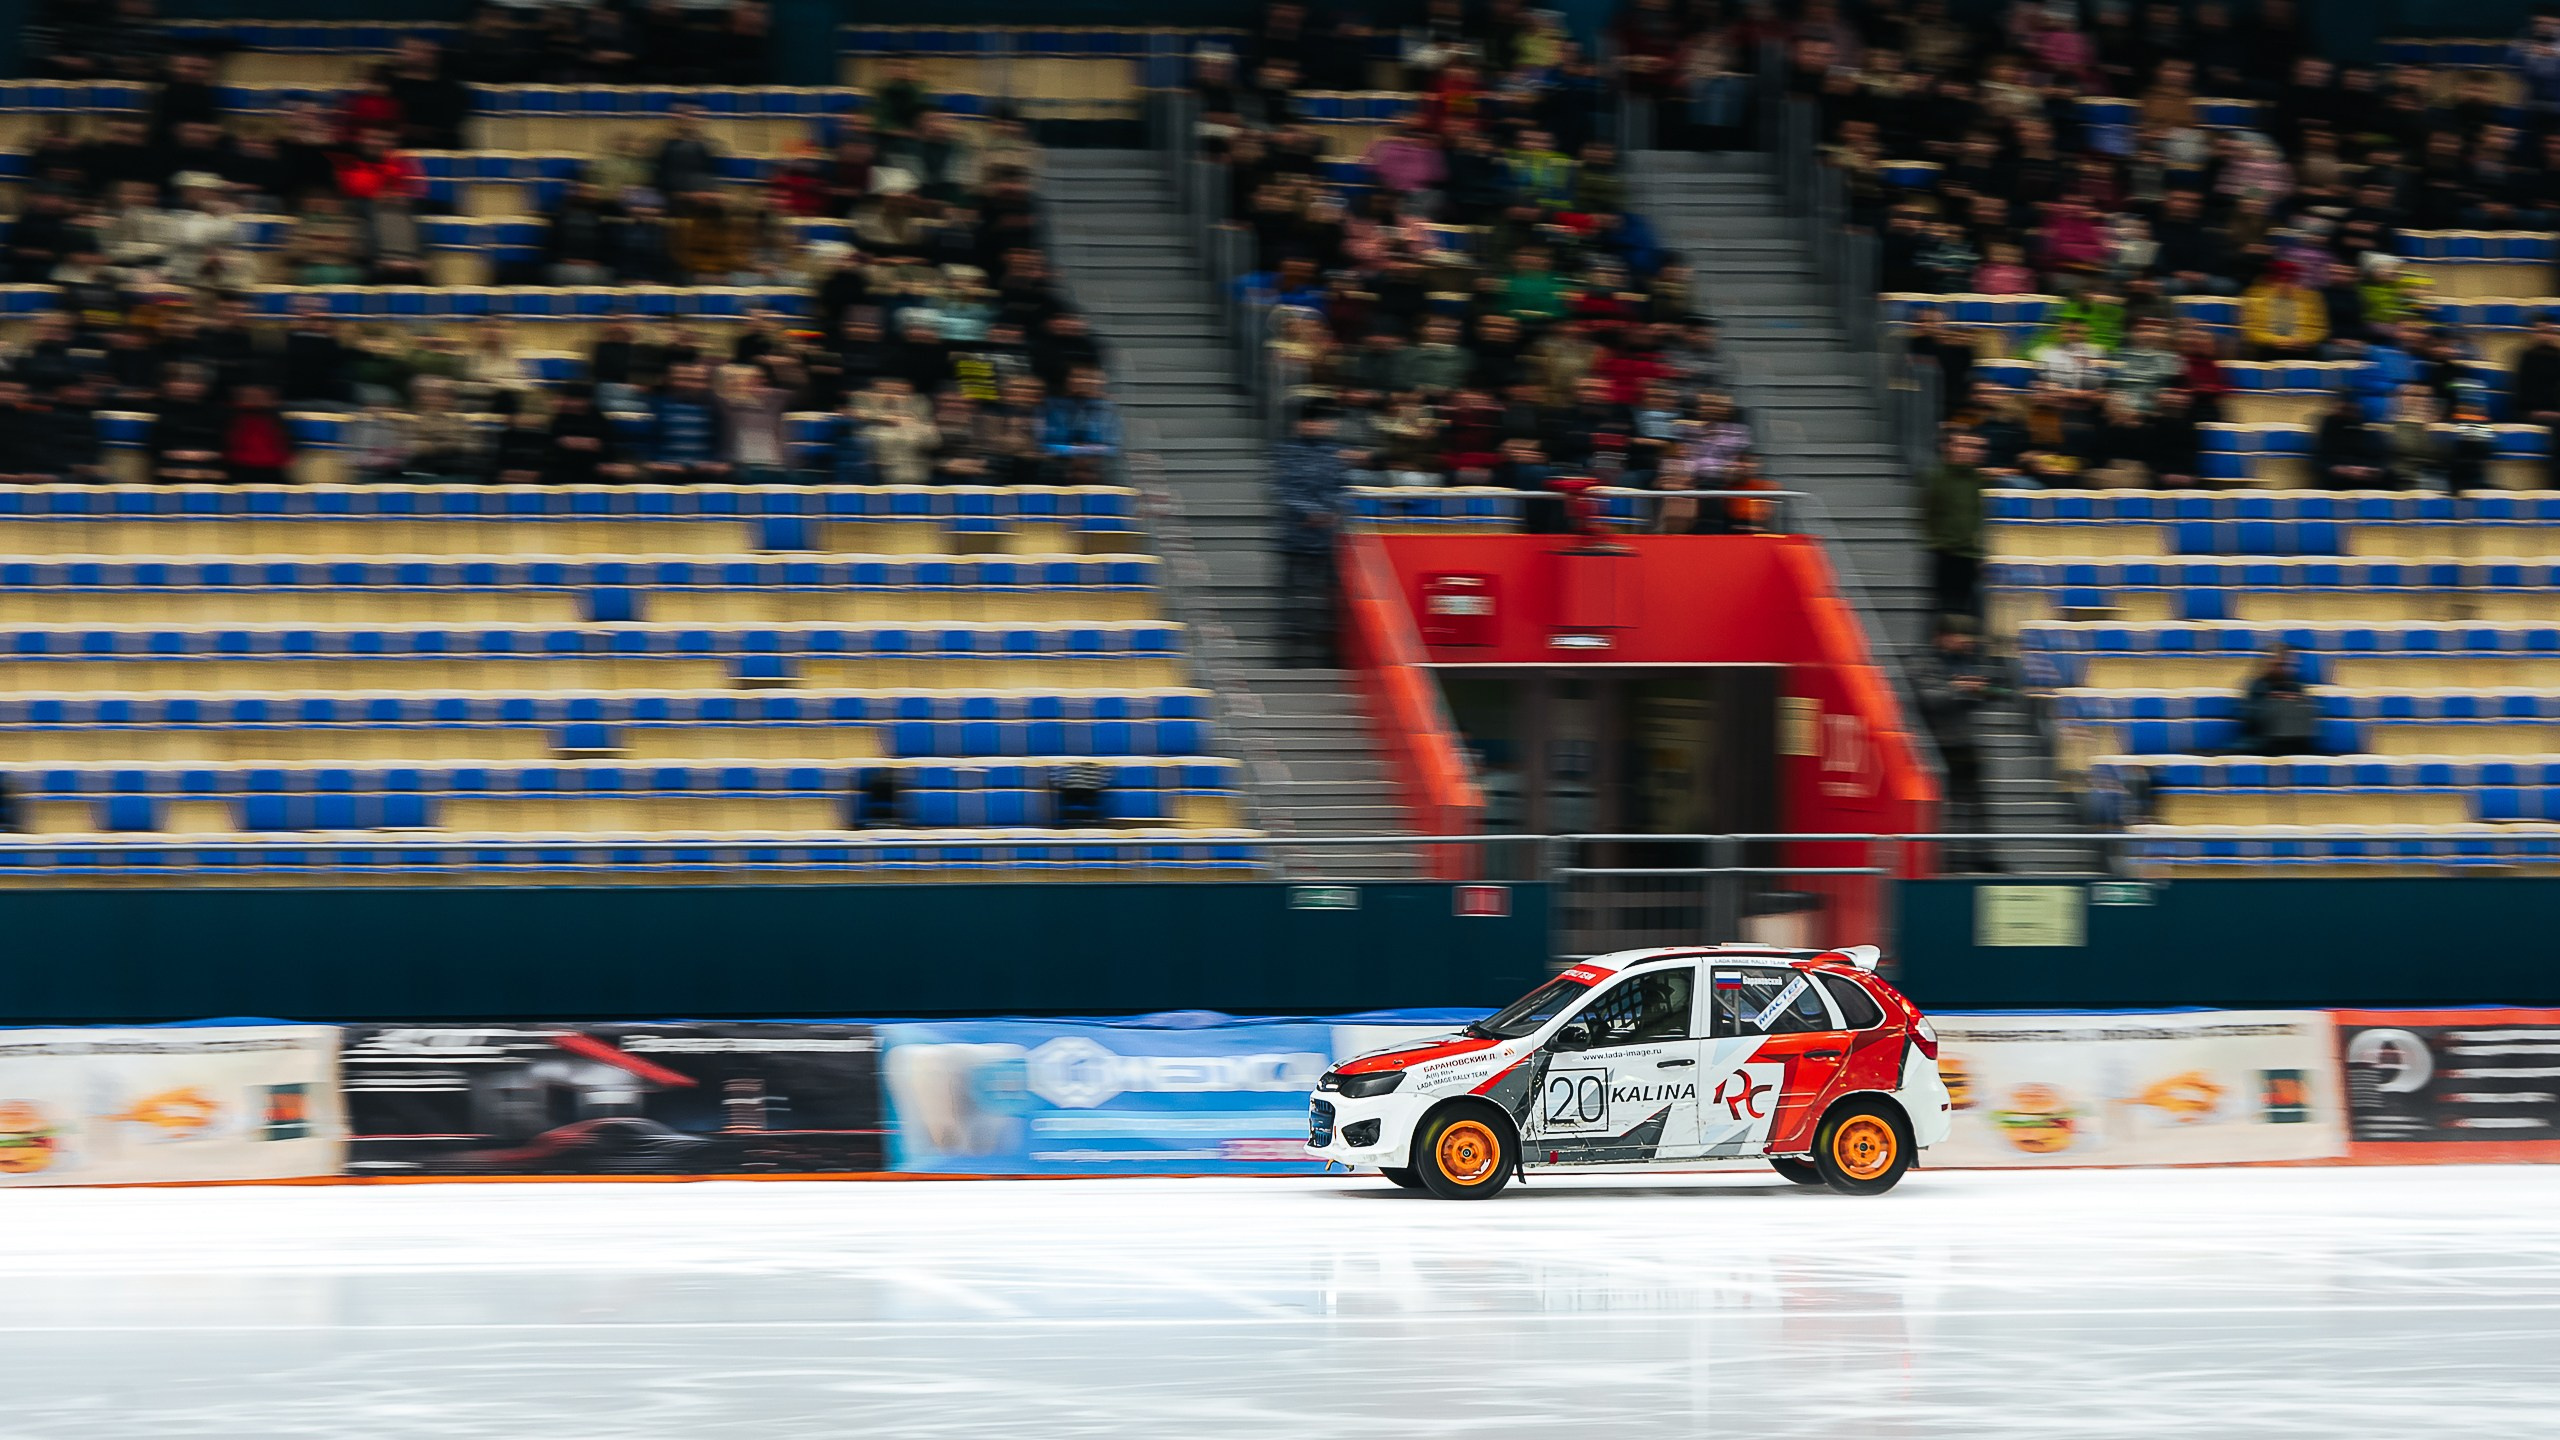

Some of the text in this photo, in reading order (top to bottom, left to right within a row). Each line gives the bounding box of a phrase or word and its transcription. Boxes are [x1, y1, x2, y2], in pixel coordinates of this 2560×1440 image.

[1758, 978, 1801, 1025] МАСТЕР
[1423, 1053, 1488, 1073] БАРАНОВСКИЙ
[1582, 1047, 1663, 1061] www.lada-image.ru
[1416, 1070, 1489, 1091] LADA IMAGE RALLY TEAM
[1549, 1075, 1604, 1123] 20
[1610, 1083, 1697, 1103] KALINA
